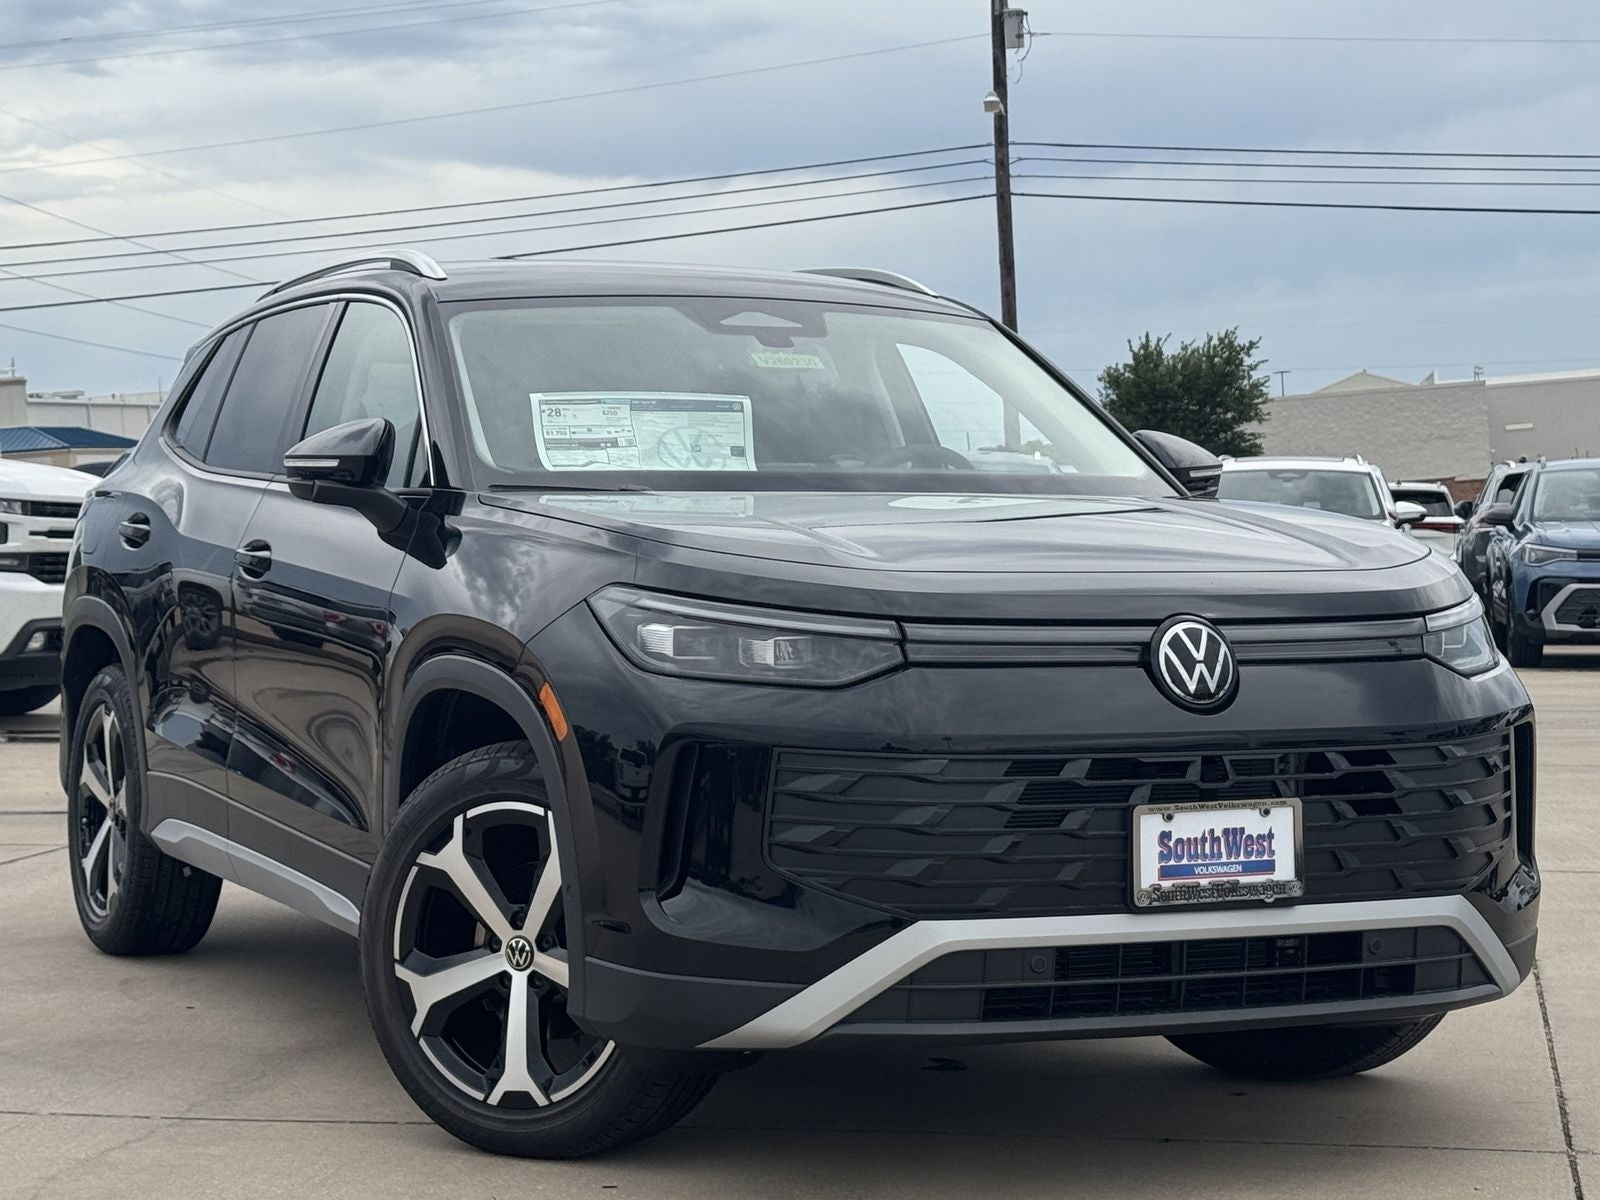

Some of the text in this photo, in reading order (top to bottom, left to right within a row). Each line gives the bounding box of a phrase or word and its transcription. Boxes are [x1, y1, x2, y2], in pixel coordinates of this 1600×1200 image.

[546, 407, 562, 418] 28
[1157, 826, 1276, 864] SouthWest
[1193, 864, 1243, 875] VOLKSWAGEN
